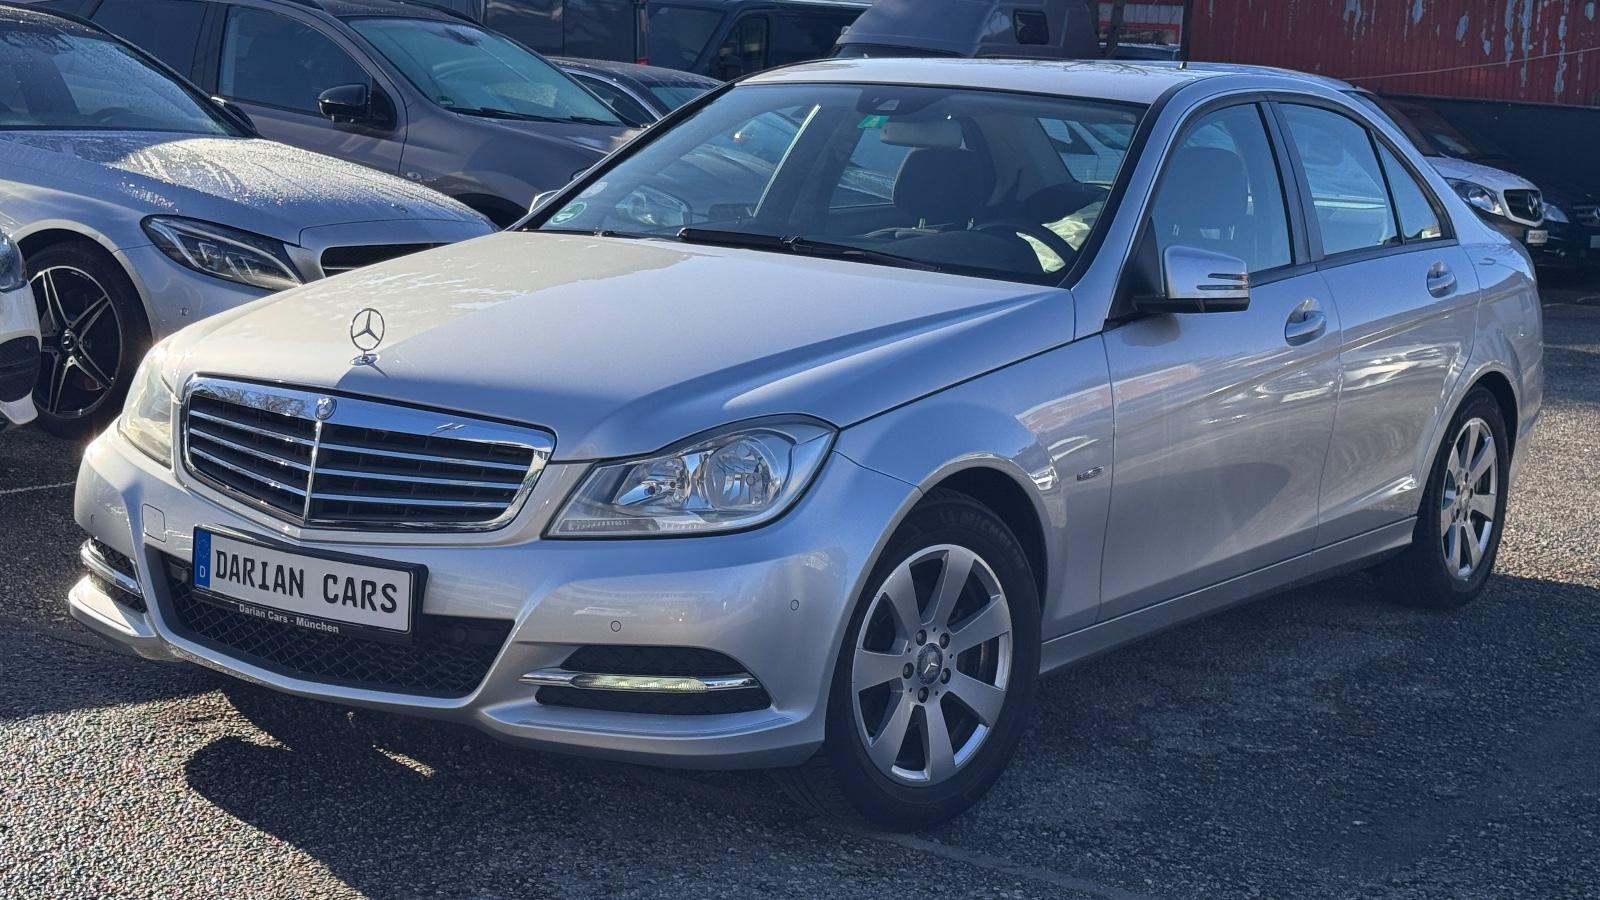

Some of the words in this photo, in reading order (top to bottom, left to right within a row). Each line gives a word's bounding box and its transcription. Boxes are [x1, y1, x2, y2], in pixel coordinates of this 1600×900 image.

[200, 566, 206, 578] D
[216, 550, 304, 598] DARIAN
[323, 573, 397, 613] CARS
[240, 604, 266, 618] Darian
[268, 611, 288, 623] Cars
[296, 617, 339, 634] München
